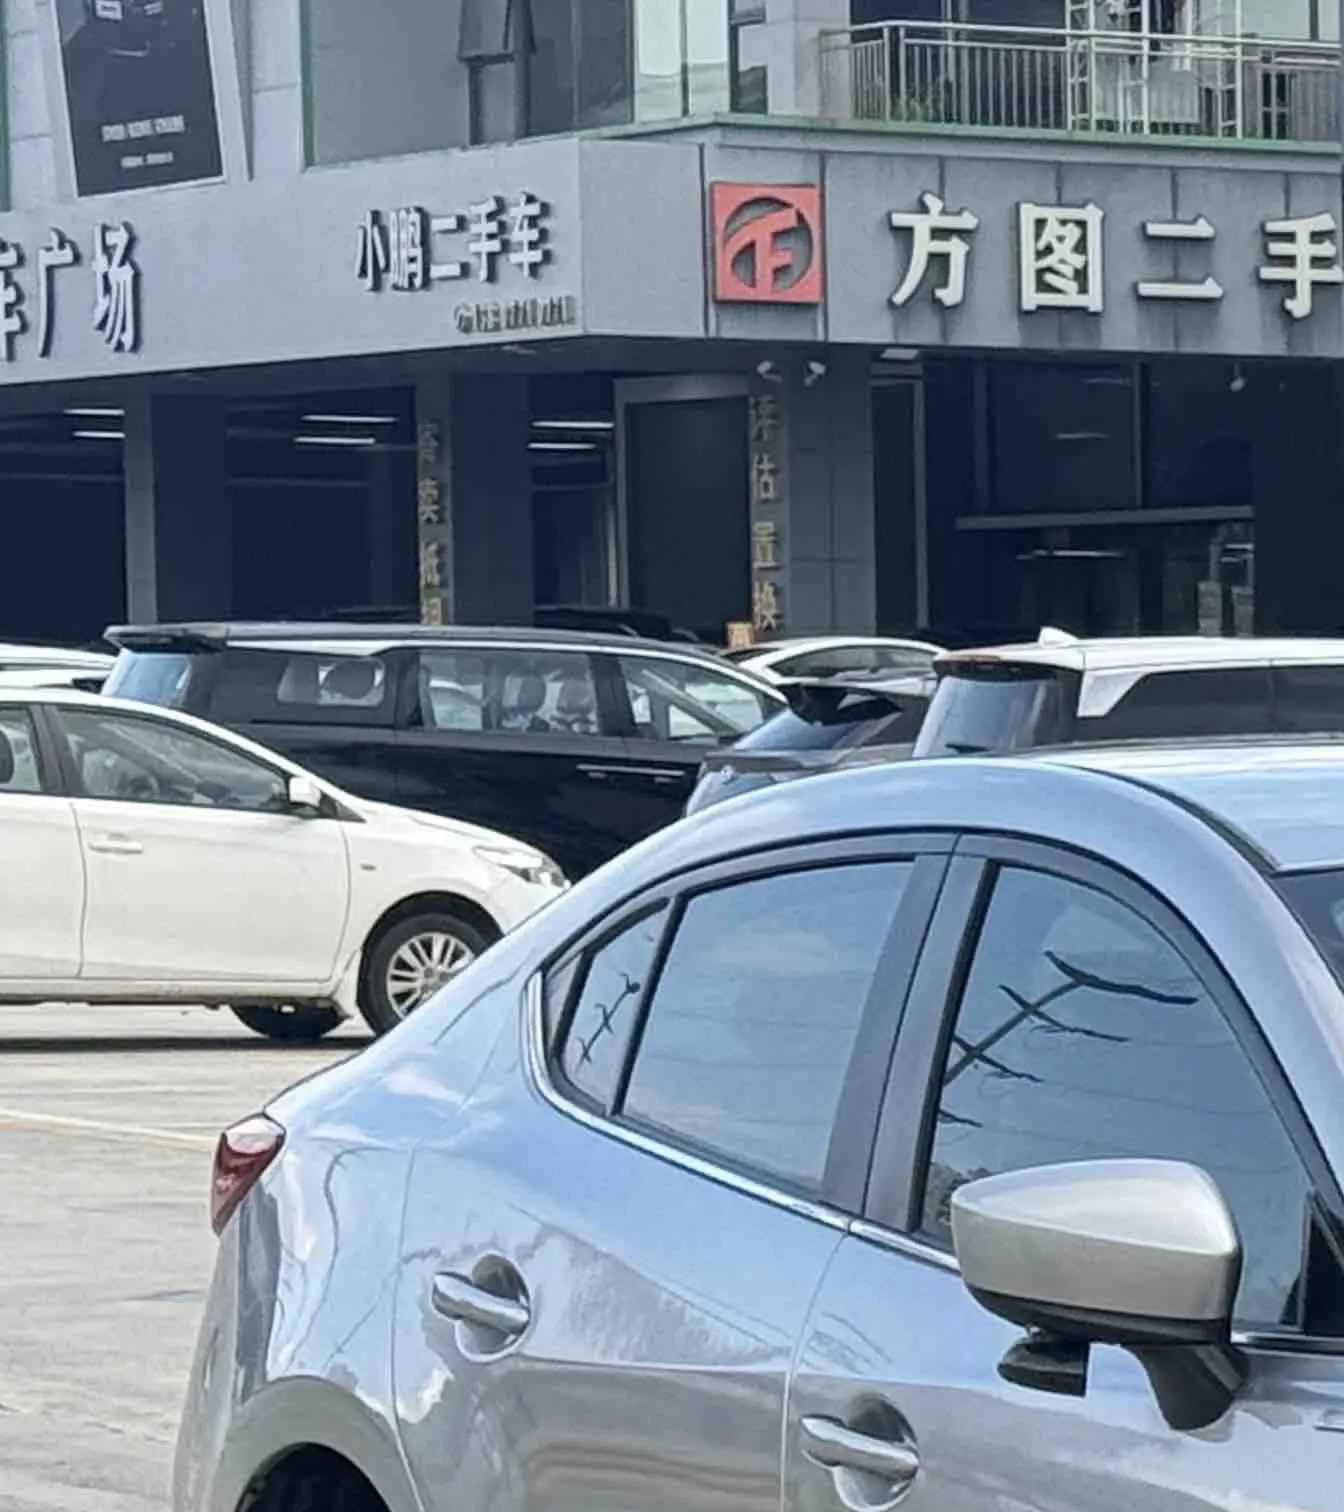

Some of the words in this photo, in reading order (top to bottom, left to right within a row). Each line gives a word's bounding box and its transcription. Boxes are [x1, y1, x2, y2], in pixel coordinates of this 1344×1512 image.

[355, 191, 544, 291] 小鹏二手车
